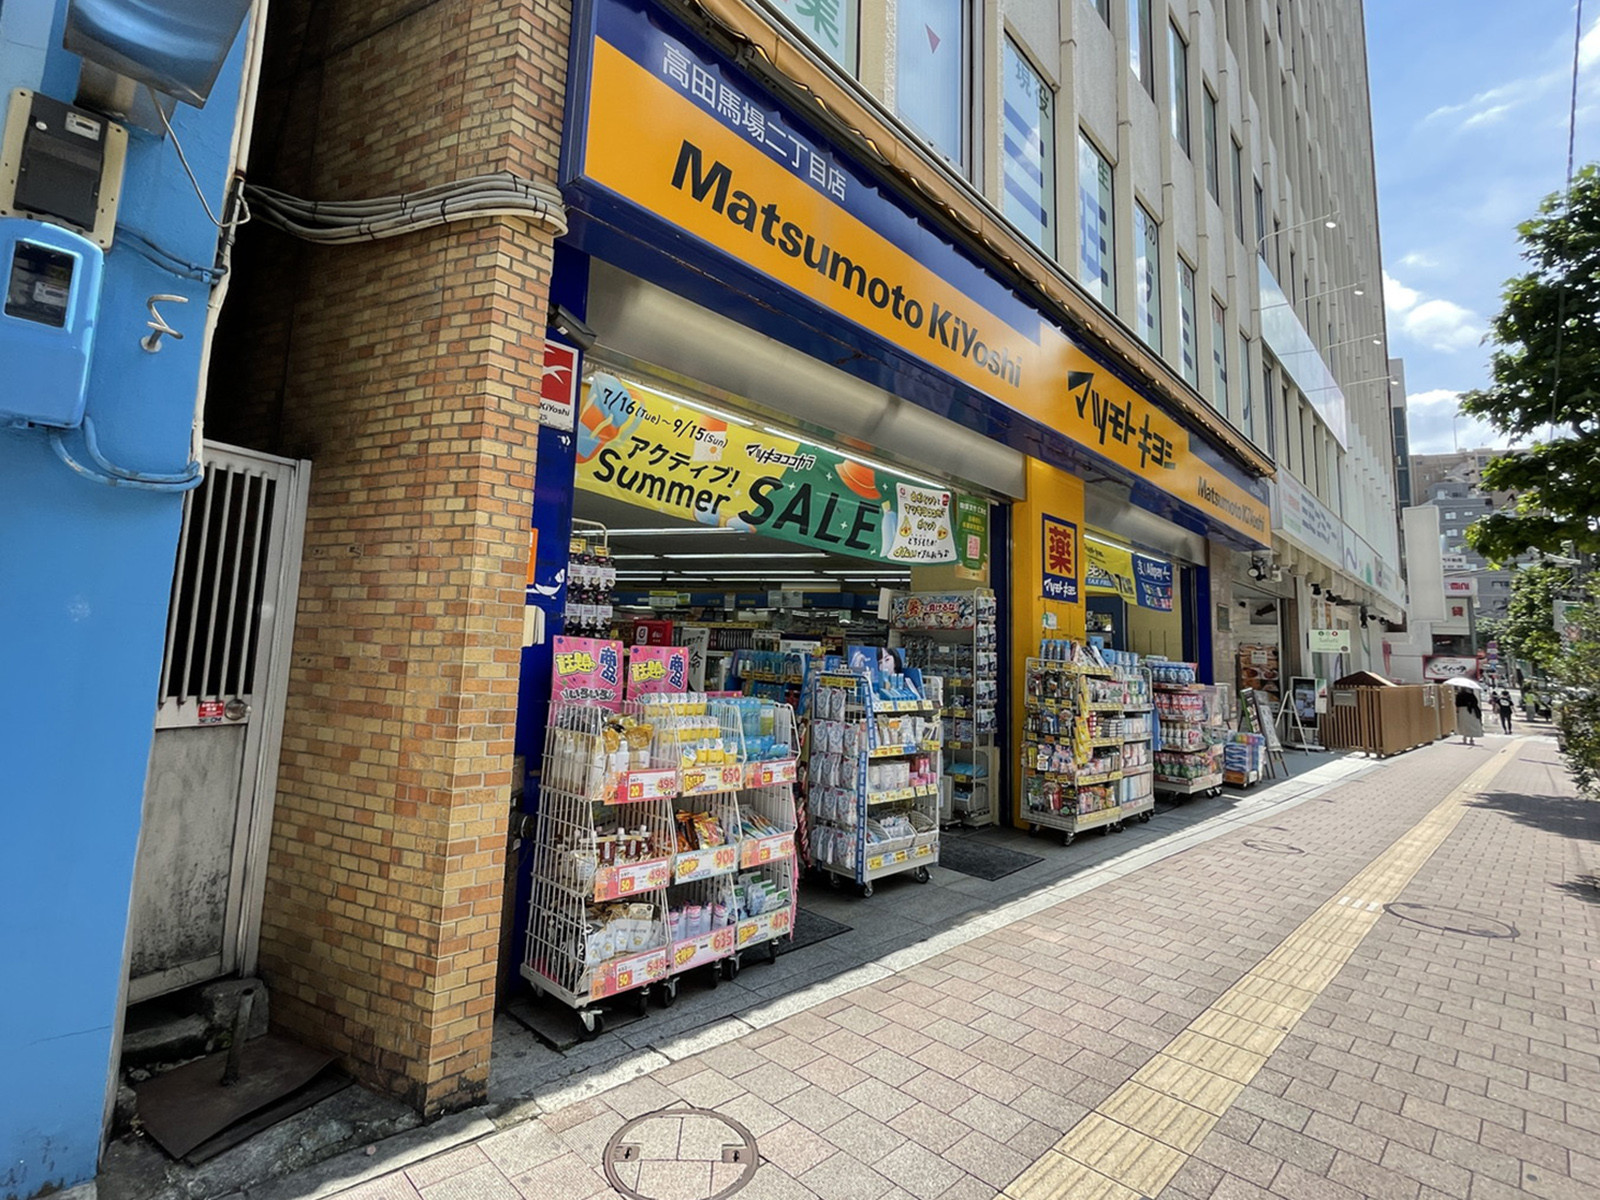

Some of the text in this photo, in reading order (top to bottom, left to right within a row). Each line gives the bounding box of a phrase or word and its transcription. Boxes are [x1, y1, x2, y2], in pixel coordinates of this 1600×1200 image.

[663, 42, 847, 201] 高田馬場二丁目店
[671, 139, 1022, 388] Matsumoto KiYoshi
[1068, 370, 1176, 470] マツモトキヨシ
[593, 448, 881, 551] Summer SALE
[1049, 526, 1072, 574] 薬
[600, 647, 618, 686] 商品
[668, 654, 684, 689] 商品
[722, 767, 740, 783] 650
[713, 930, 733, 949] 635
